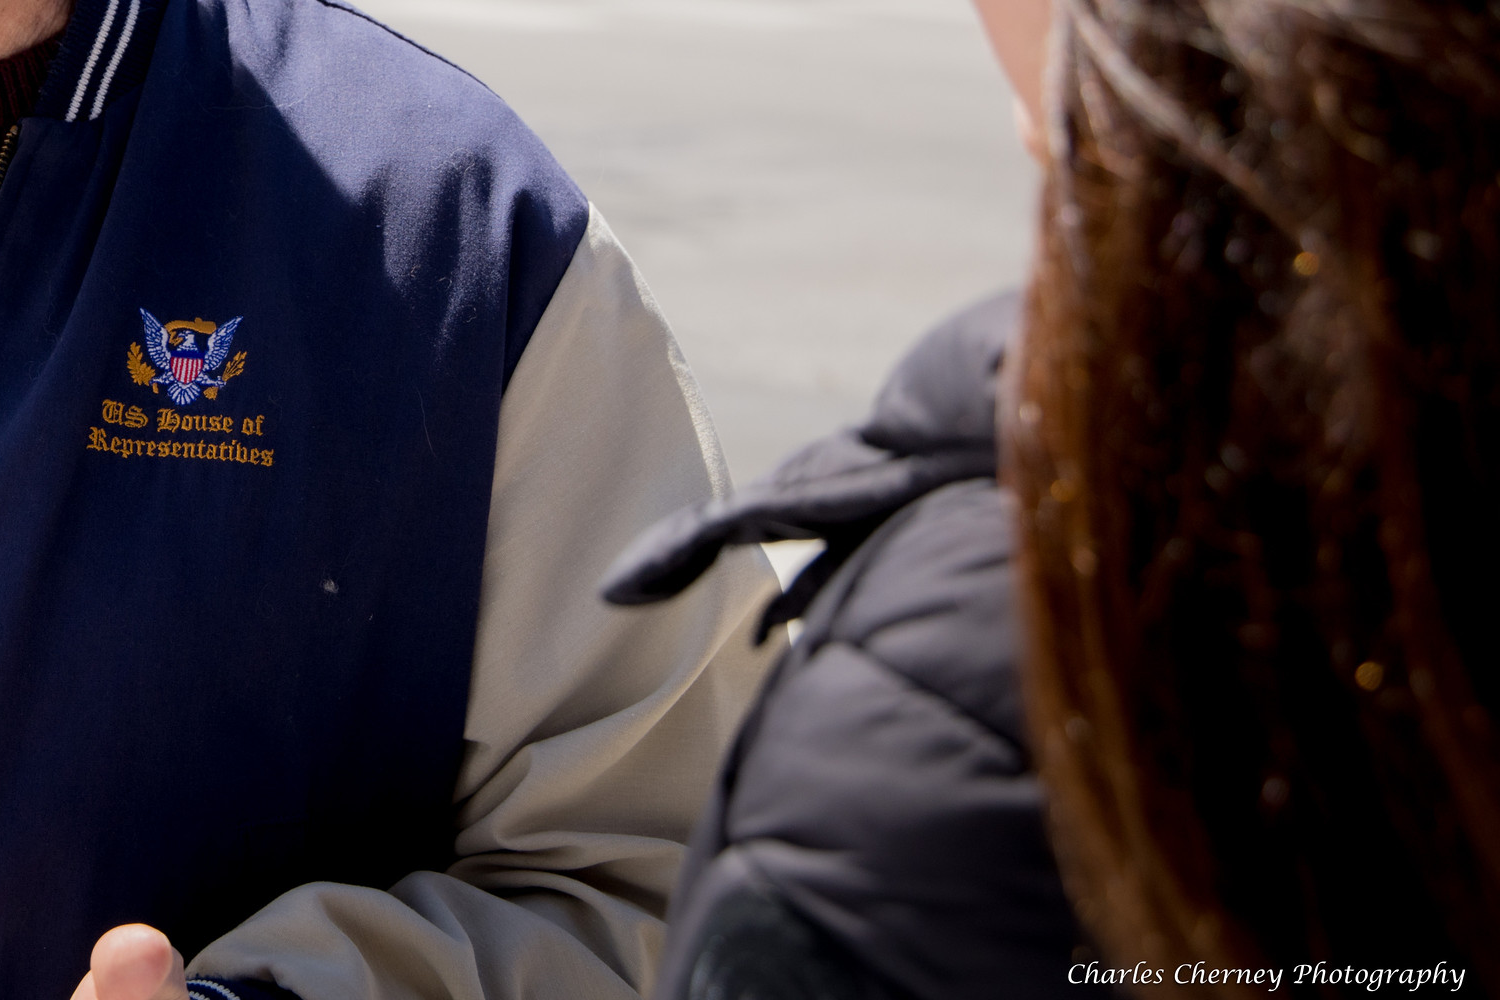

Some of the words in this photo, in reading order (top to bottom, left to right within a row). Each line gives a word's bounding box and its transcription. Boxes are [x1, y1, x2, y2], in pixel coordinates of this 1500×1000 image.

[102, 399, 149, 428] US
[157, 408, 234, 434] House
[241, 414, 265, 437] of
[86, 427, 275, 467] Representatives
